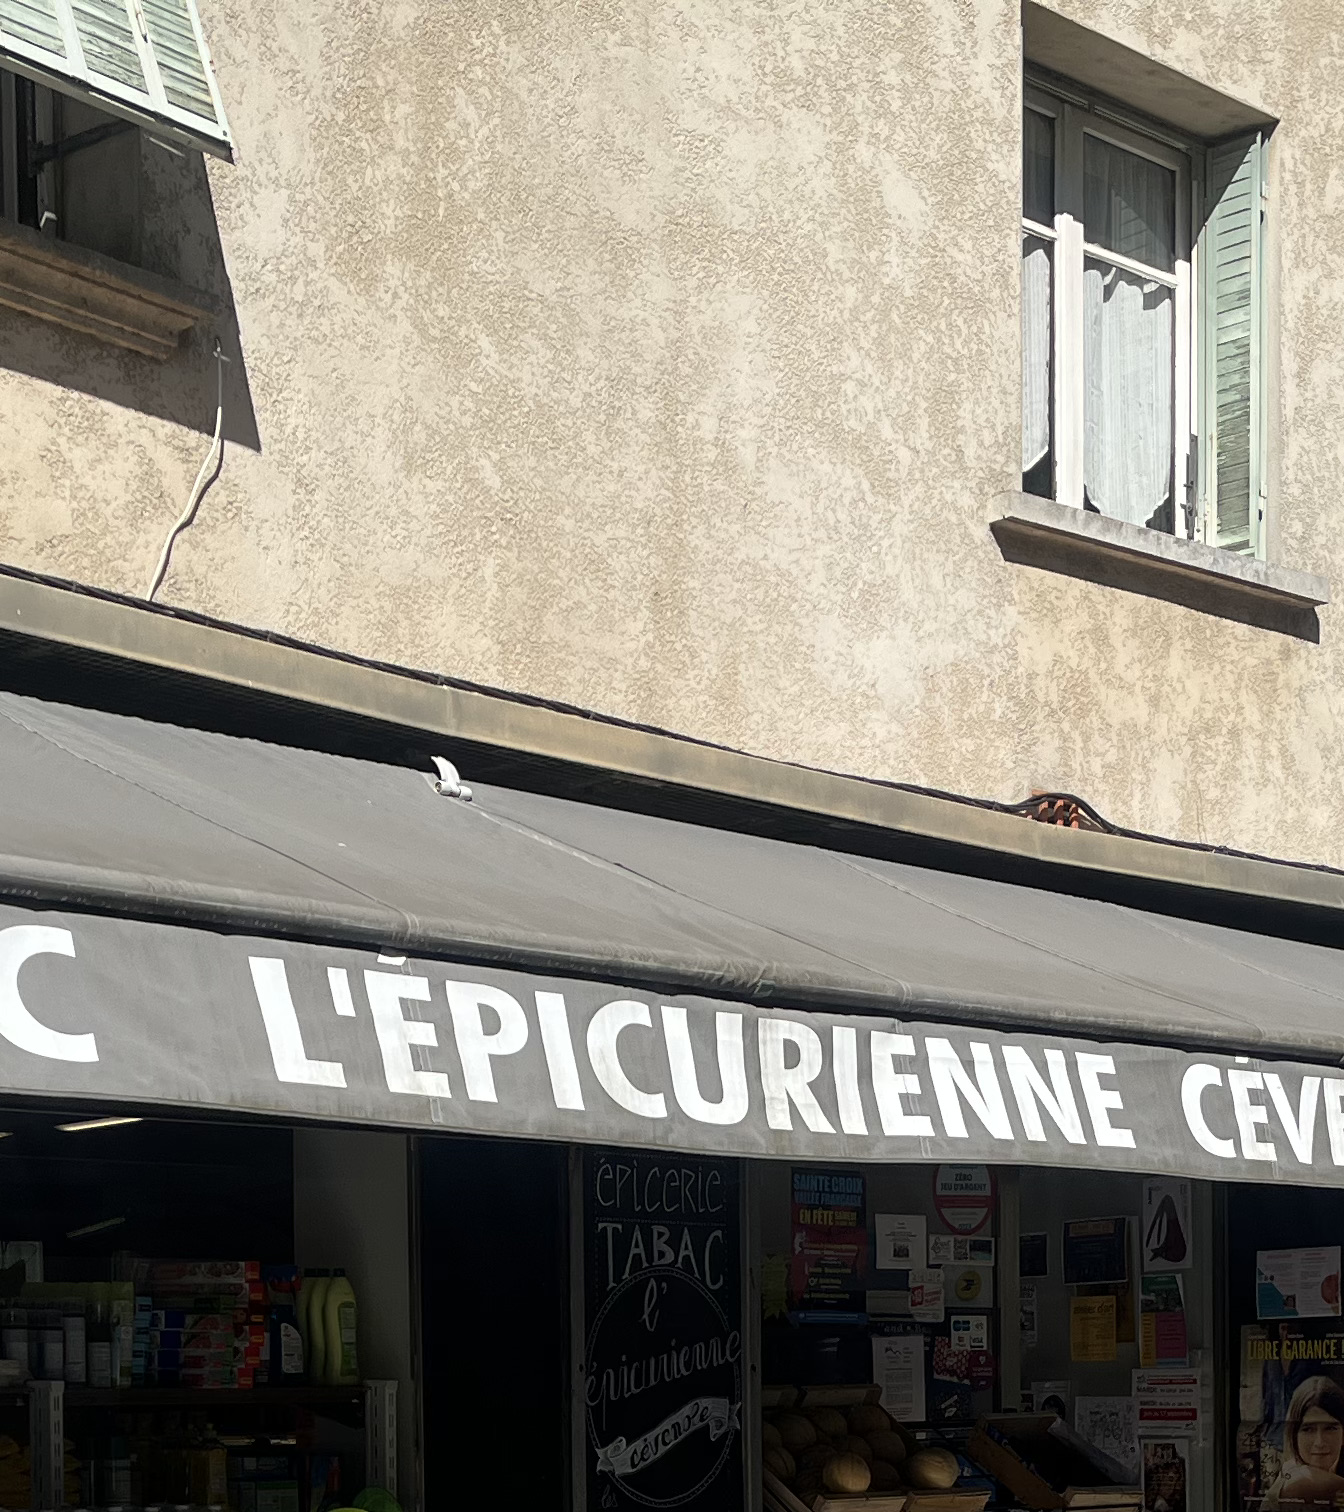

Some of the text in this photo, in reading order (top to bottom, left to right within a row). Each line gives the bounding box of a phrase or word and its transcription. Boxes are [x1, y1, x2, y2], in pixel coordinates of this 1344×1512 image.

[248, 949, 1137, 1149] L'ÉPICURIENNE
[793, 1173, 863, 1194] SAINTE CROIX
[598, 1222, 724, 1290] TABAC
[1282, 1338, 1337, 1360] GARANCE
